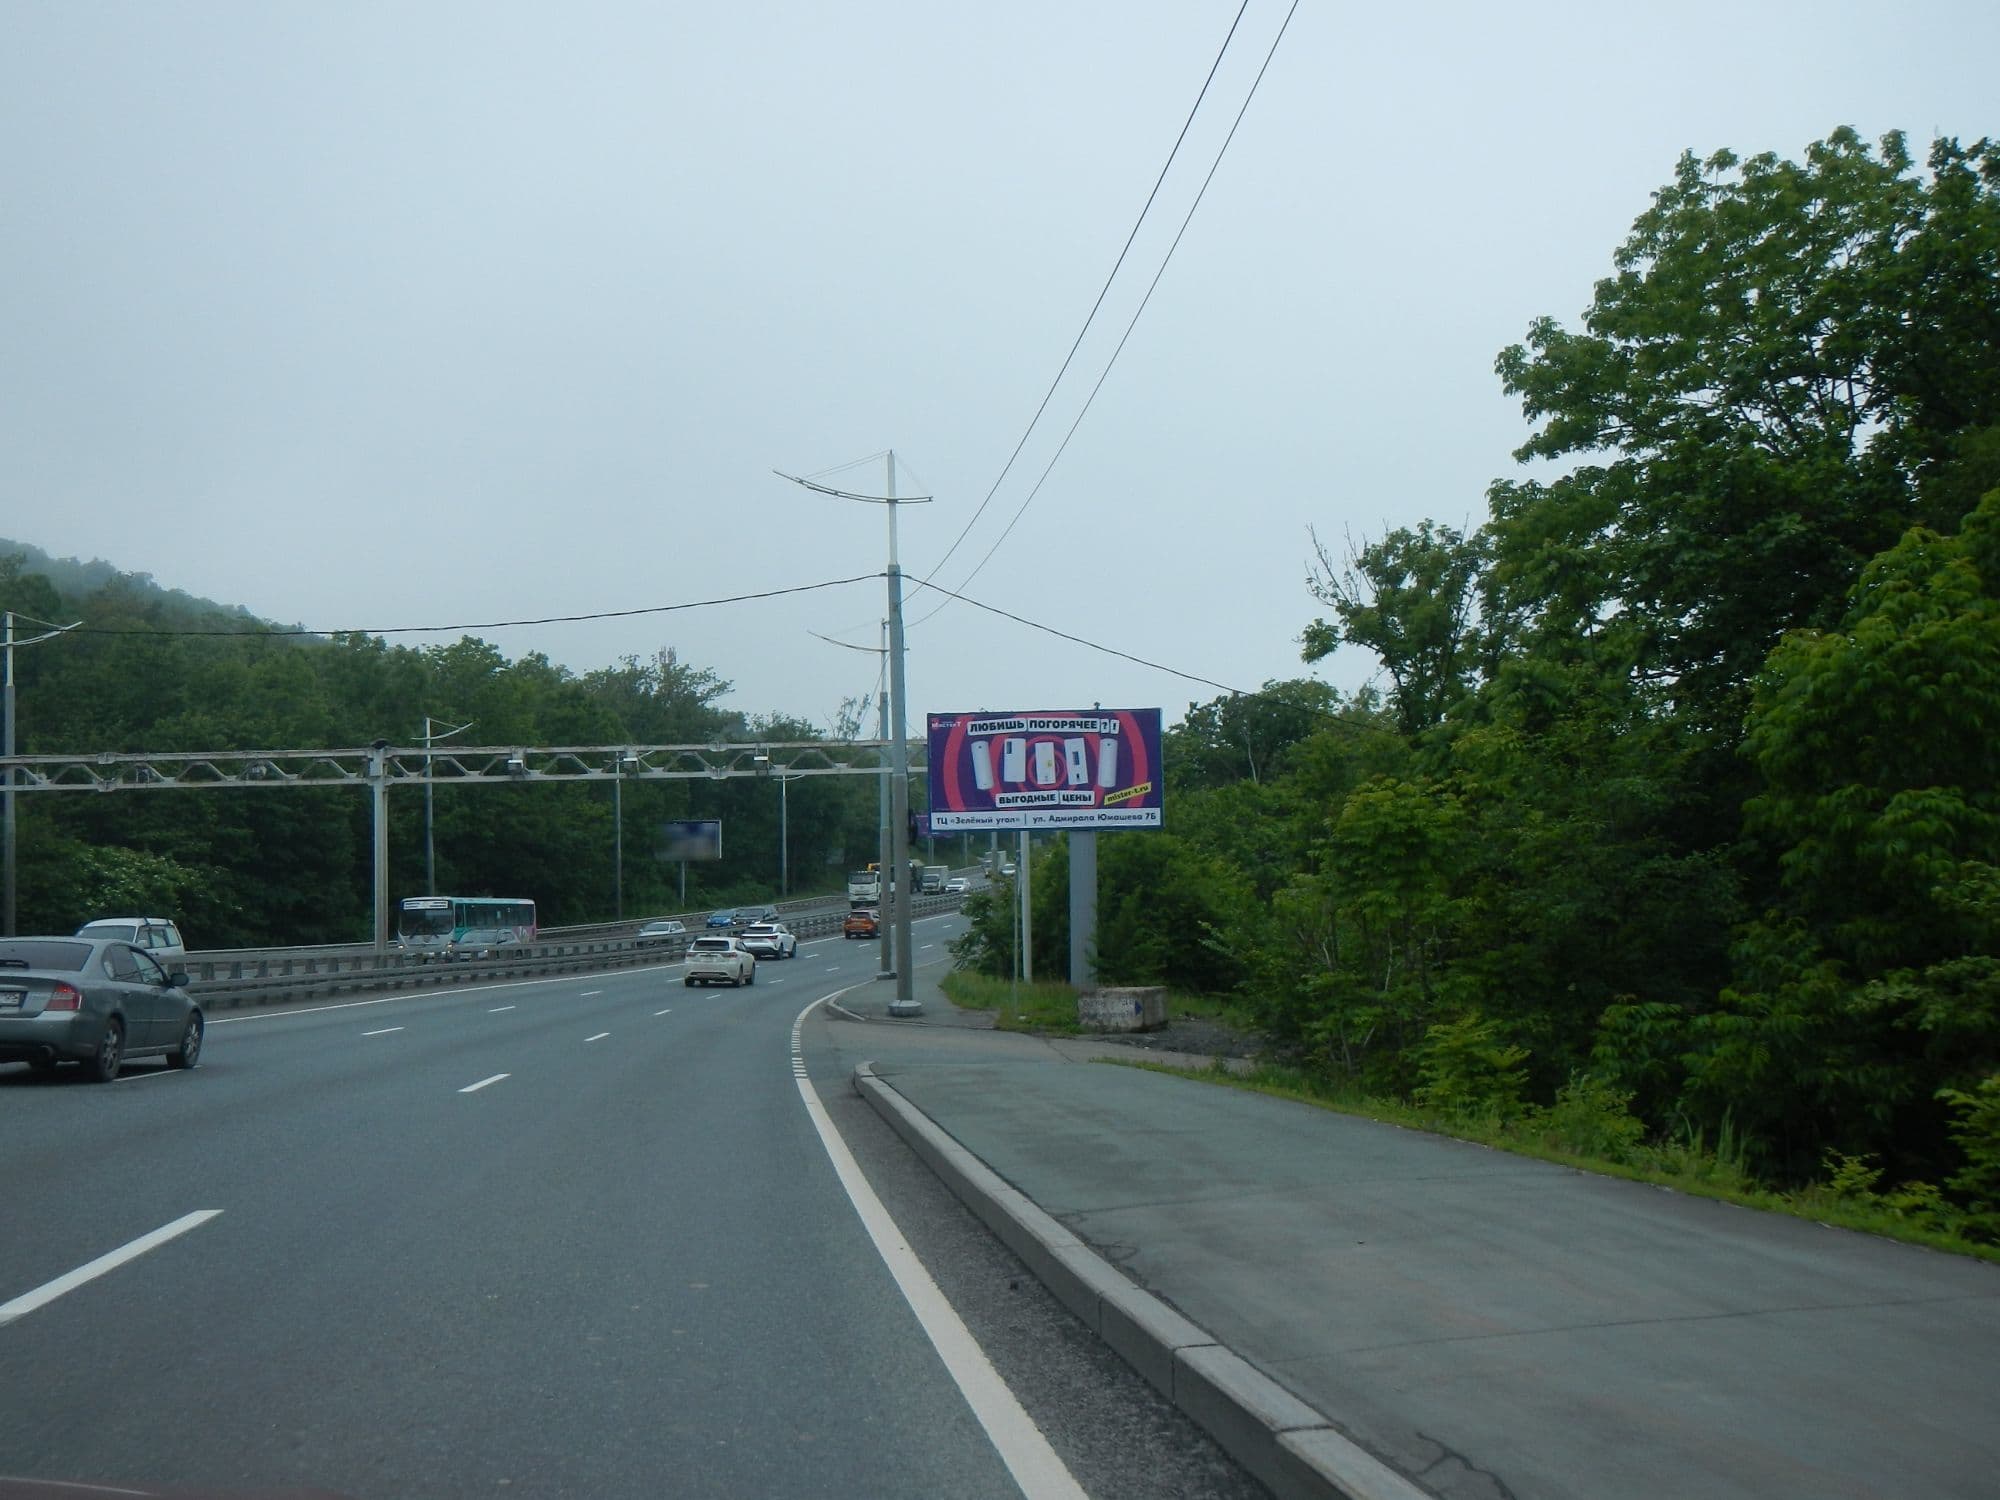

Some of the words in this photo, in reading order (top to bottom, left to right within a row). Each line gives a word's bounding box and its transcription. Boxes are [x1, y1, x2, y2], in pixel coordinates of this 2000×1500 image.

[969, 720, 1025, 732] ЛЮБИШЬ
[998, 793, 1056, 804] ВЫГОДНЫЕ
[1062, 793, 1092, 803] ЦЕНЫ
[1107, 785, 1149, 802] mister-t.ru
[936, 817, 948, 825] ТЦ
[1032, 816, 1046, 825] ул.
[1048, 815, 1095, 823] Адмирала
